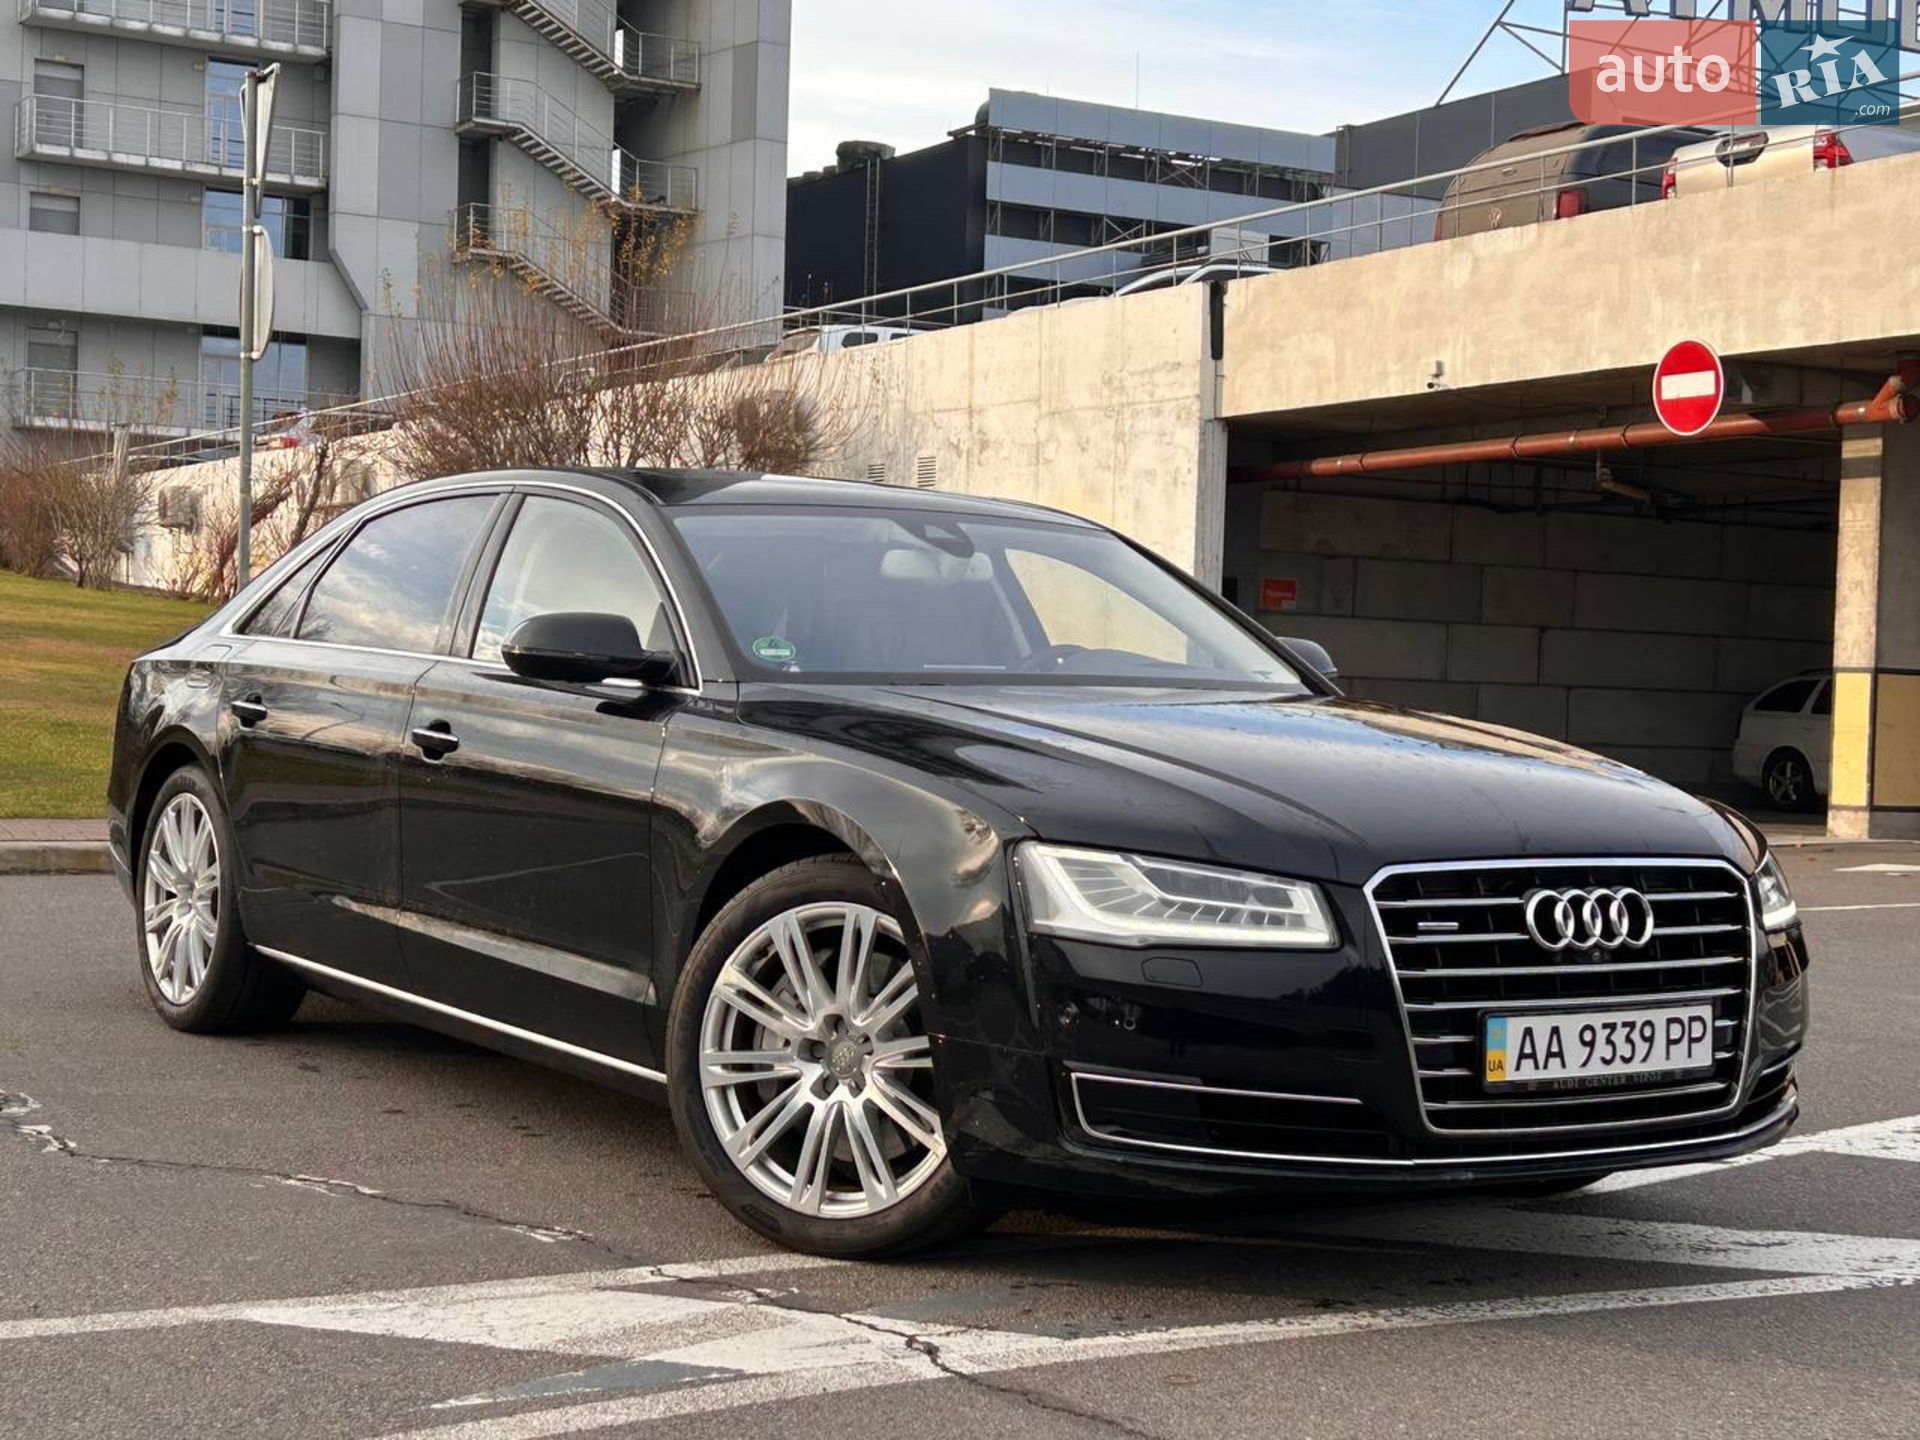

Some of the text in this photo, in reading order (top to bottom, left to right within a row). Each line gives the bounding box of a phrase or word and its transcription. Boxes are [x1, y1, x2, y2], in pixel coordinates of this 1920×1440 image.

[1514, 1015, 1708, 1072] AA 9339 PP
[1488, 1060, 1504, 1072] UA
